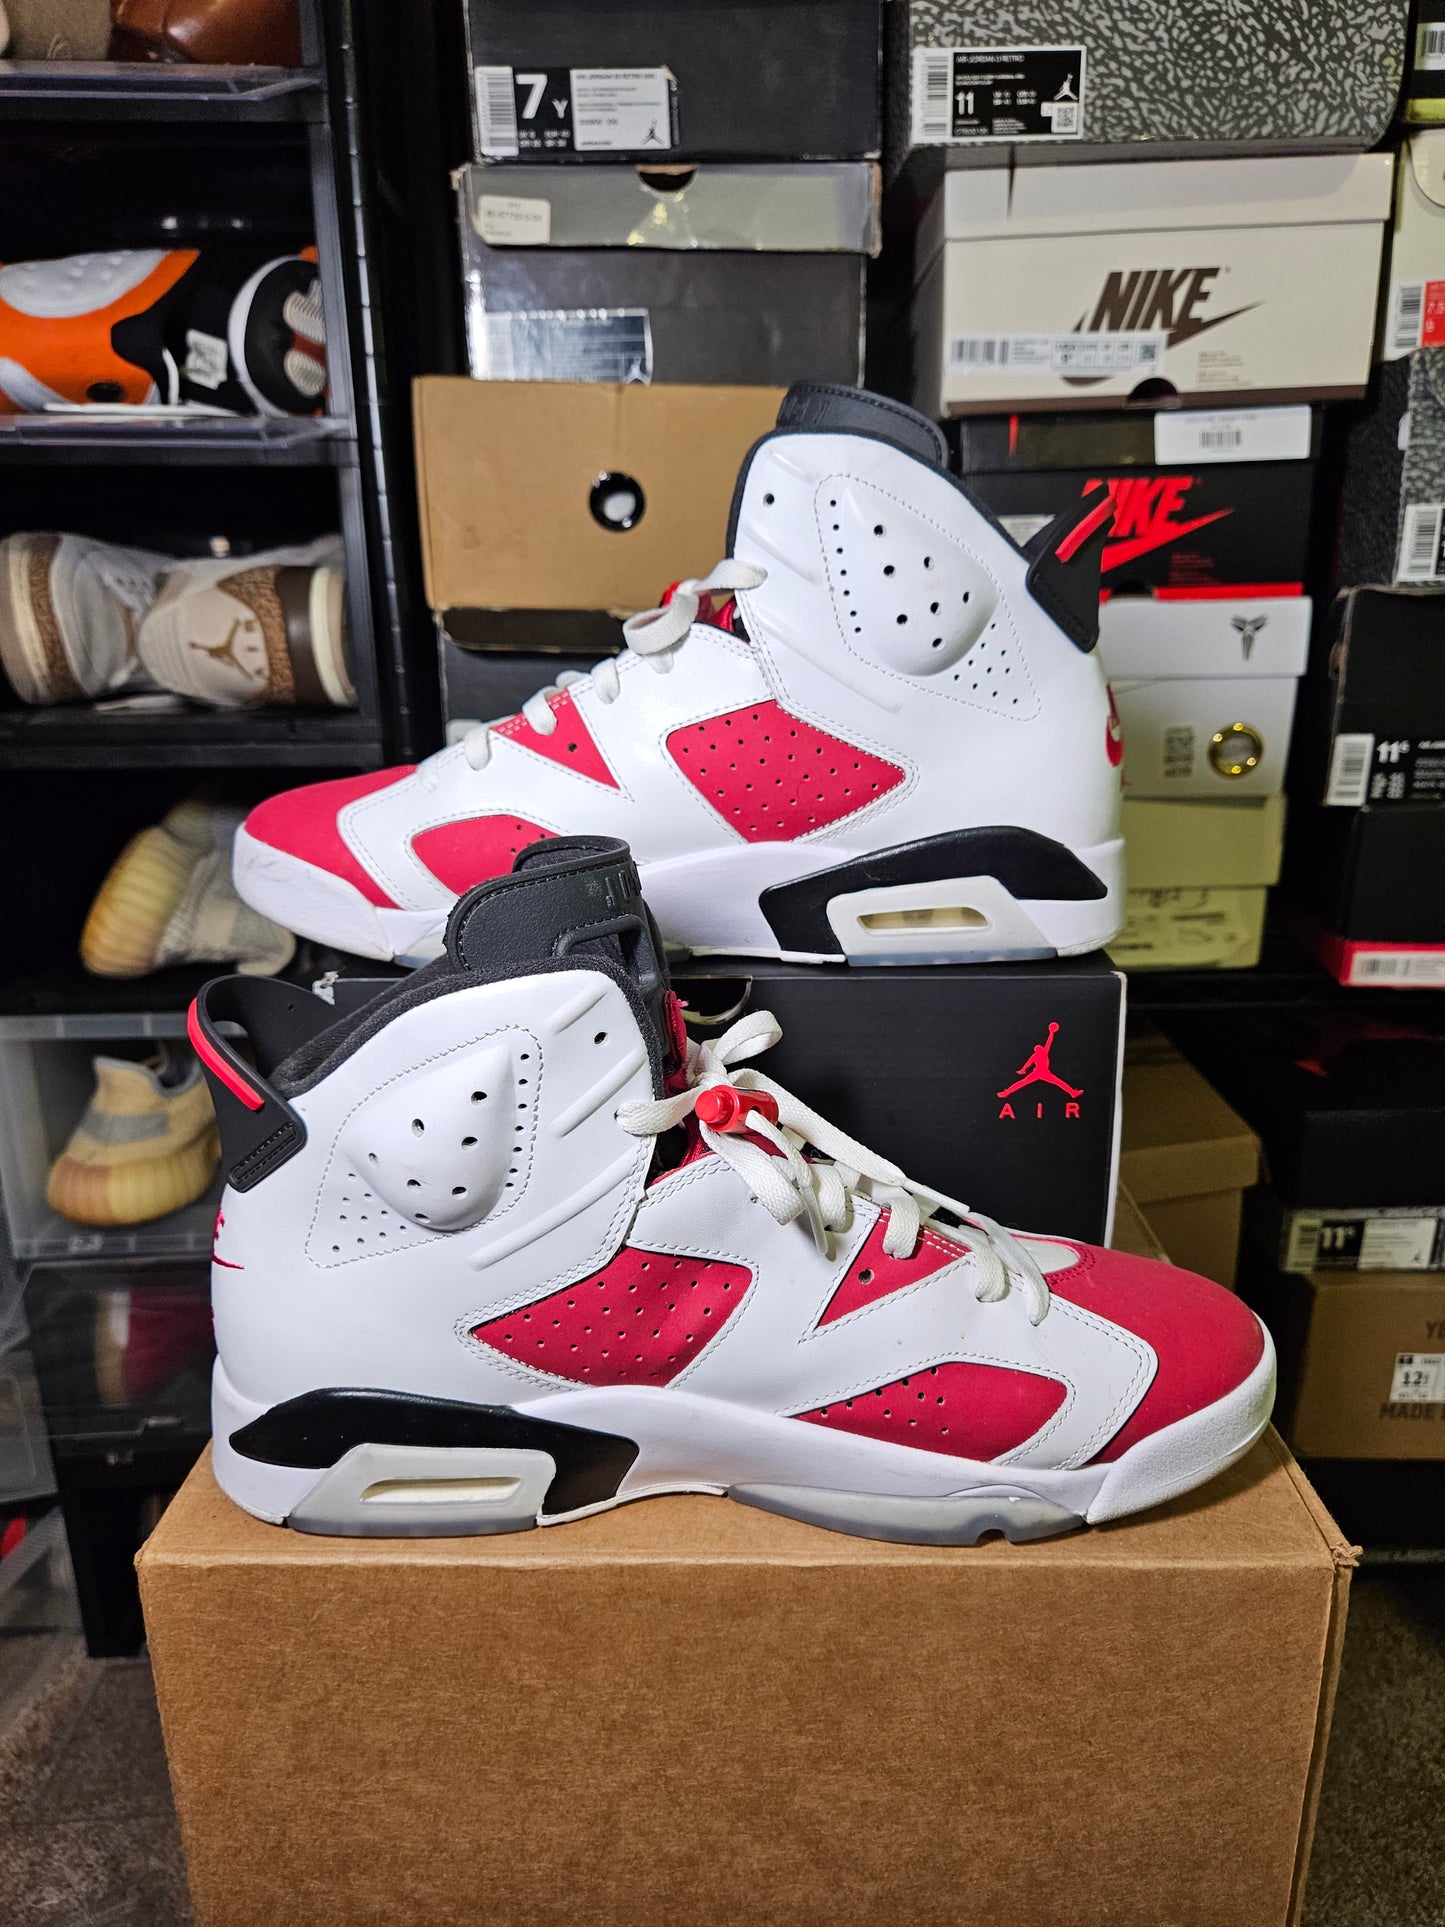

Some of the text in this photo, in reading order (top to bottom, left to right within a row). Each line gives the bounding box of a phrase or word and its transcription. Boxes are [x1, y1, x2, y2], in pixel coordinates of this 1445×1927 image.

[515, 73, 548, 119] 7
[955, 90, 974, 115] 11
[1089, 268, 1220, 331] NIKE
[998, 1102, 1081, 1119] AIR
[1379, 1402, 1437, 1420] MADE
